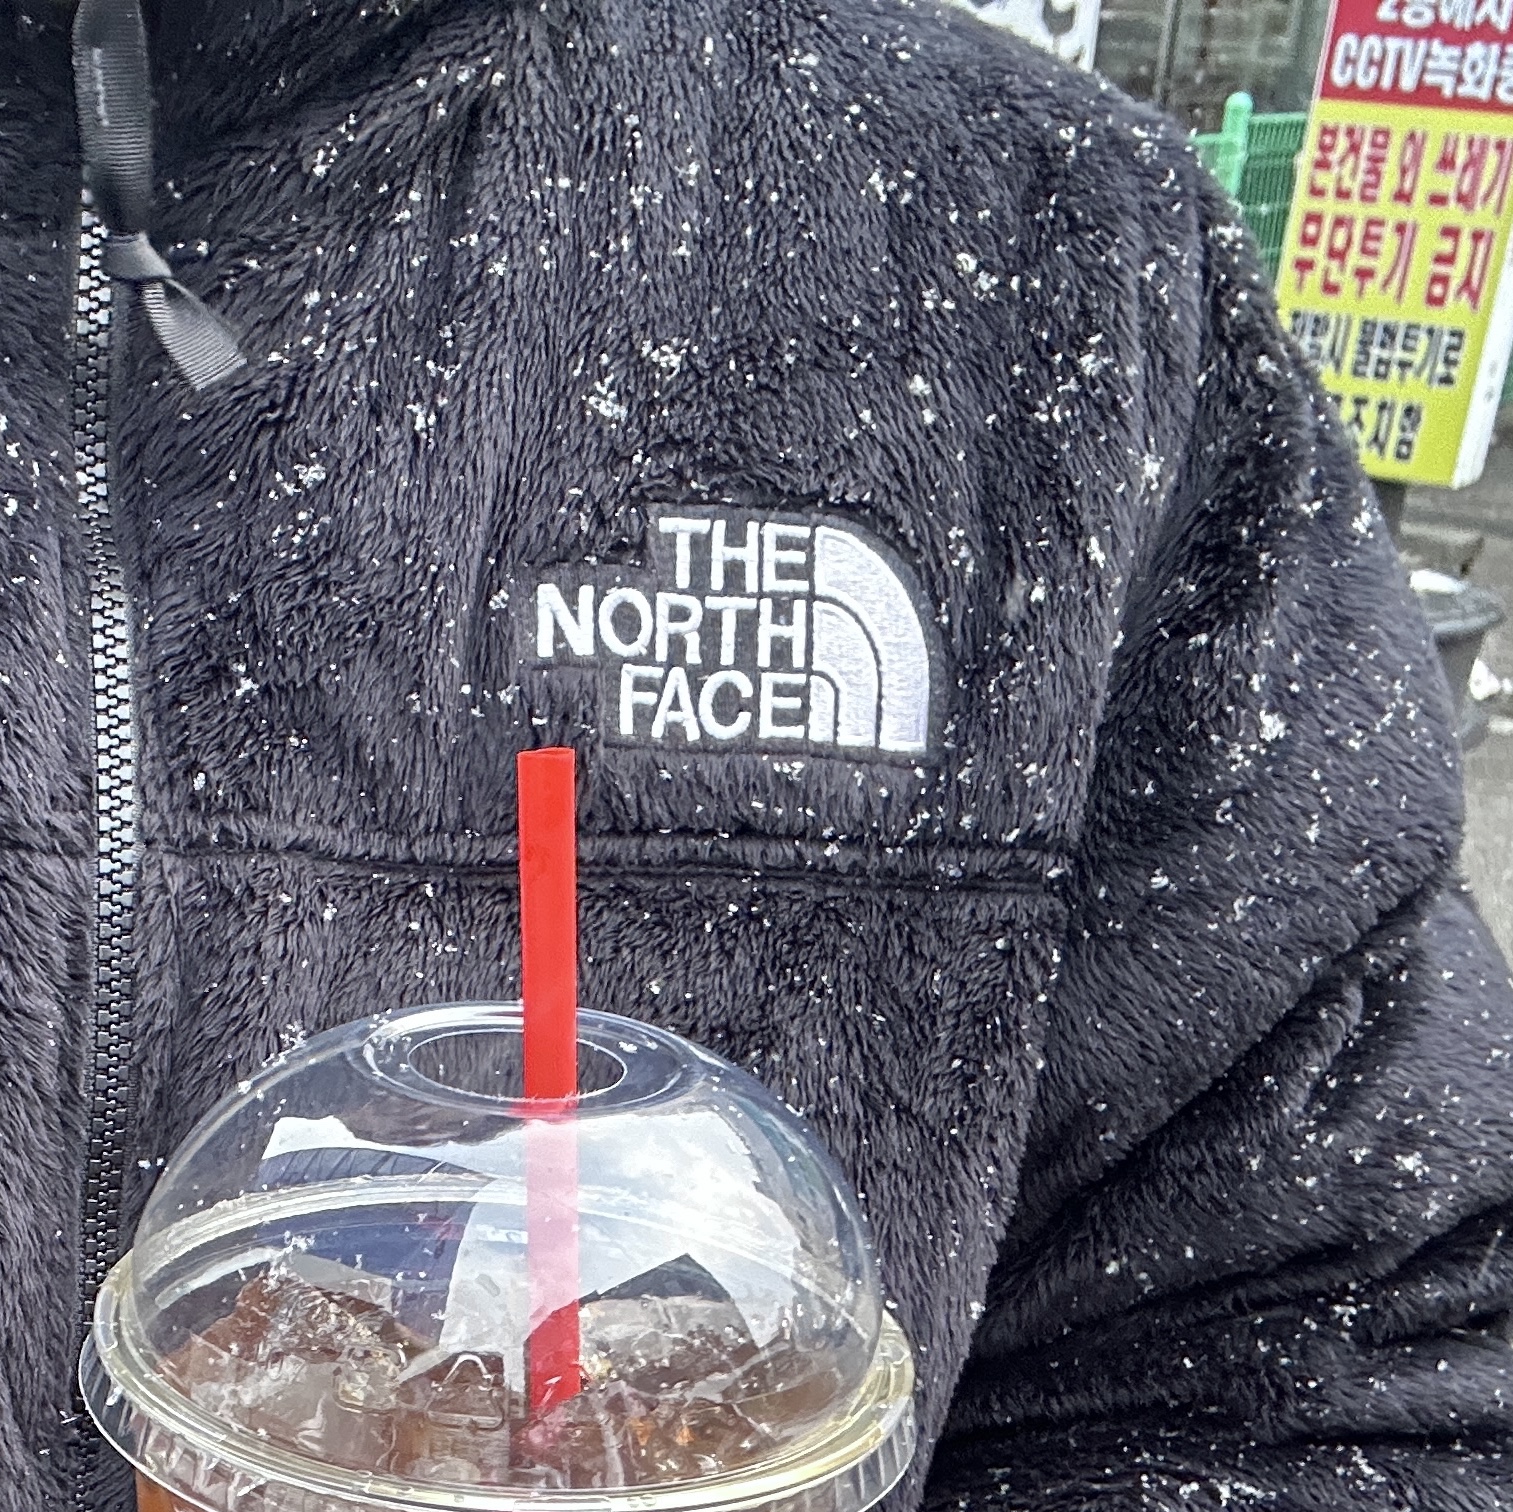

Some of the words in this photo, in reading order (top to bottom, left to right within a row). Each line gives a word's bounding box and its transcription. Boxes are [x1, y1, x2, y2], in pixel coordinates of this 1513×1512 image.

[1294, 212, 1418, 304] 무단투기
[1425, 226, 1496, 312] 금지
[658, 516, 811, 593] THE
[536, 583, 807, 668] NORTH
[618, 662, 808, 742] FACE
